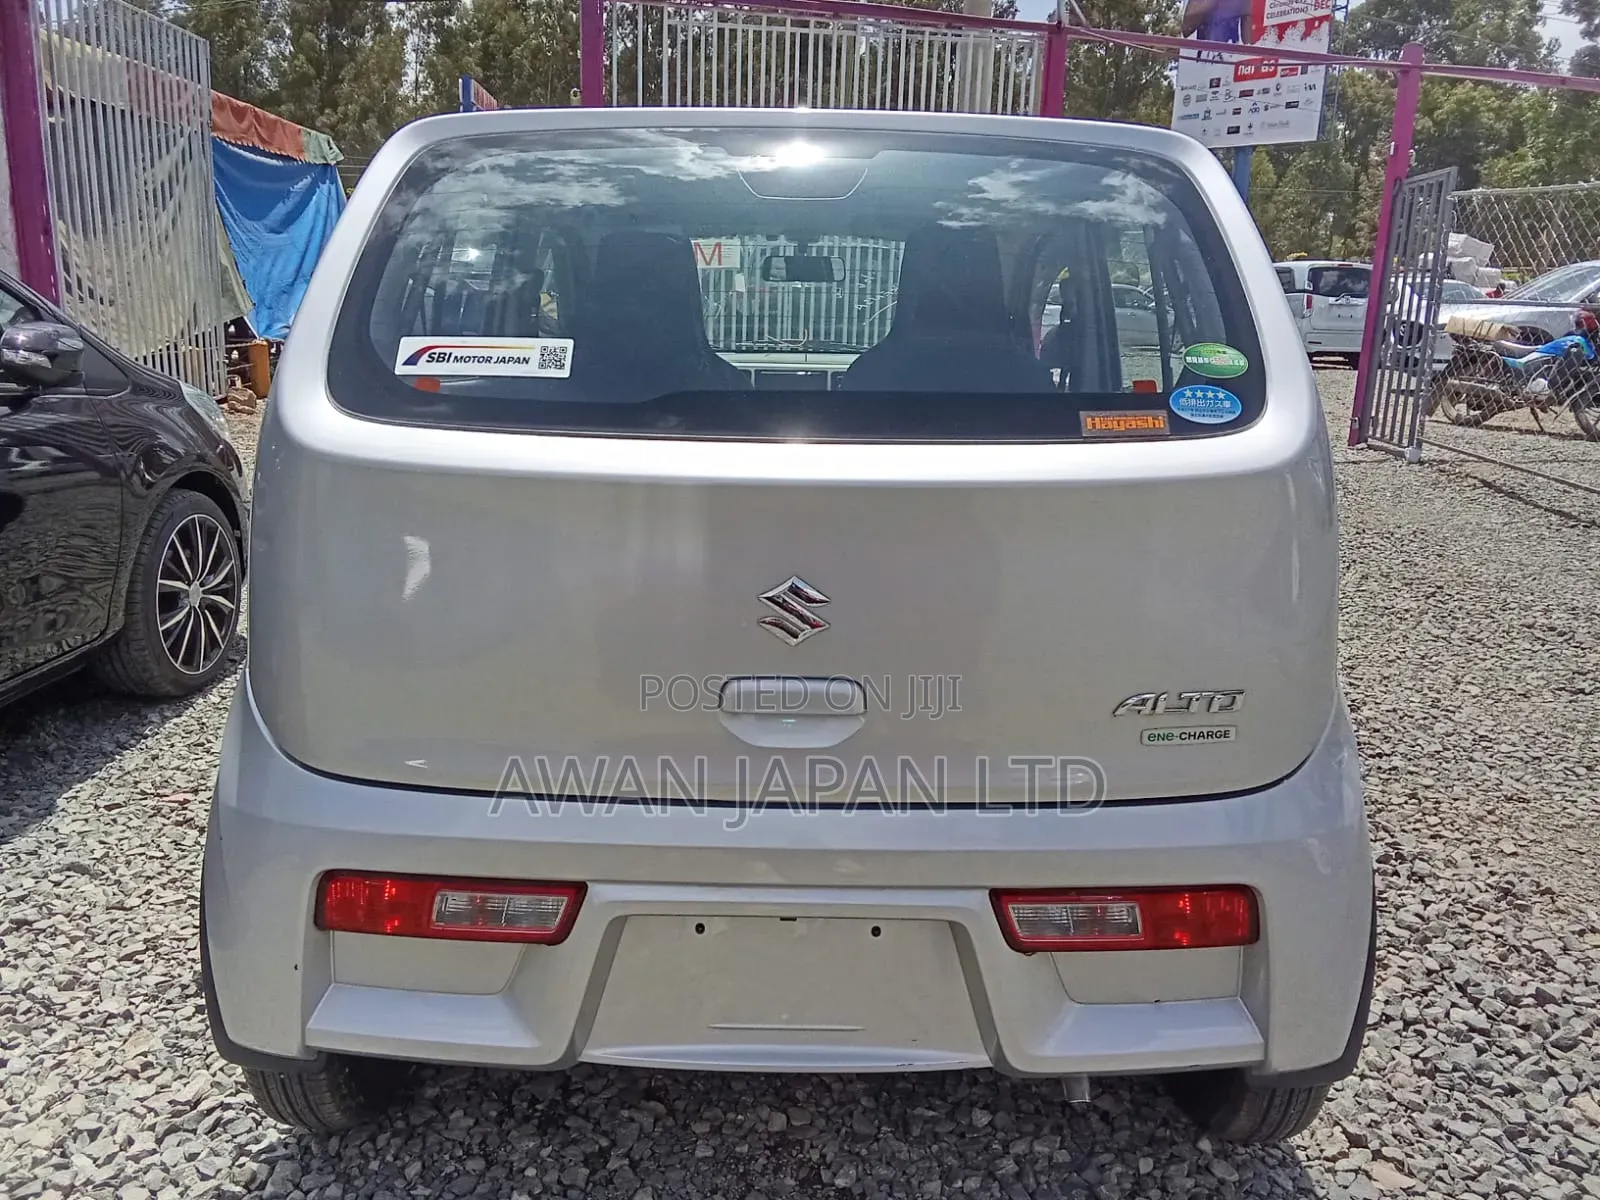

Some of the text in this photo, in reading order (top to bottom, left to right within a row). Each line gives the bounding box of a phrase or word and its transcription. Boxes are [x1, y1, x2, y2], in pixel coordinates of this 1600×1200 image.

[425, 351, 531, 365] SBI MOTOR JAPAN
[1086, 416, 1165, 431] Hayashi
[1111, 689, 1246, 717] ALTO
